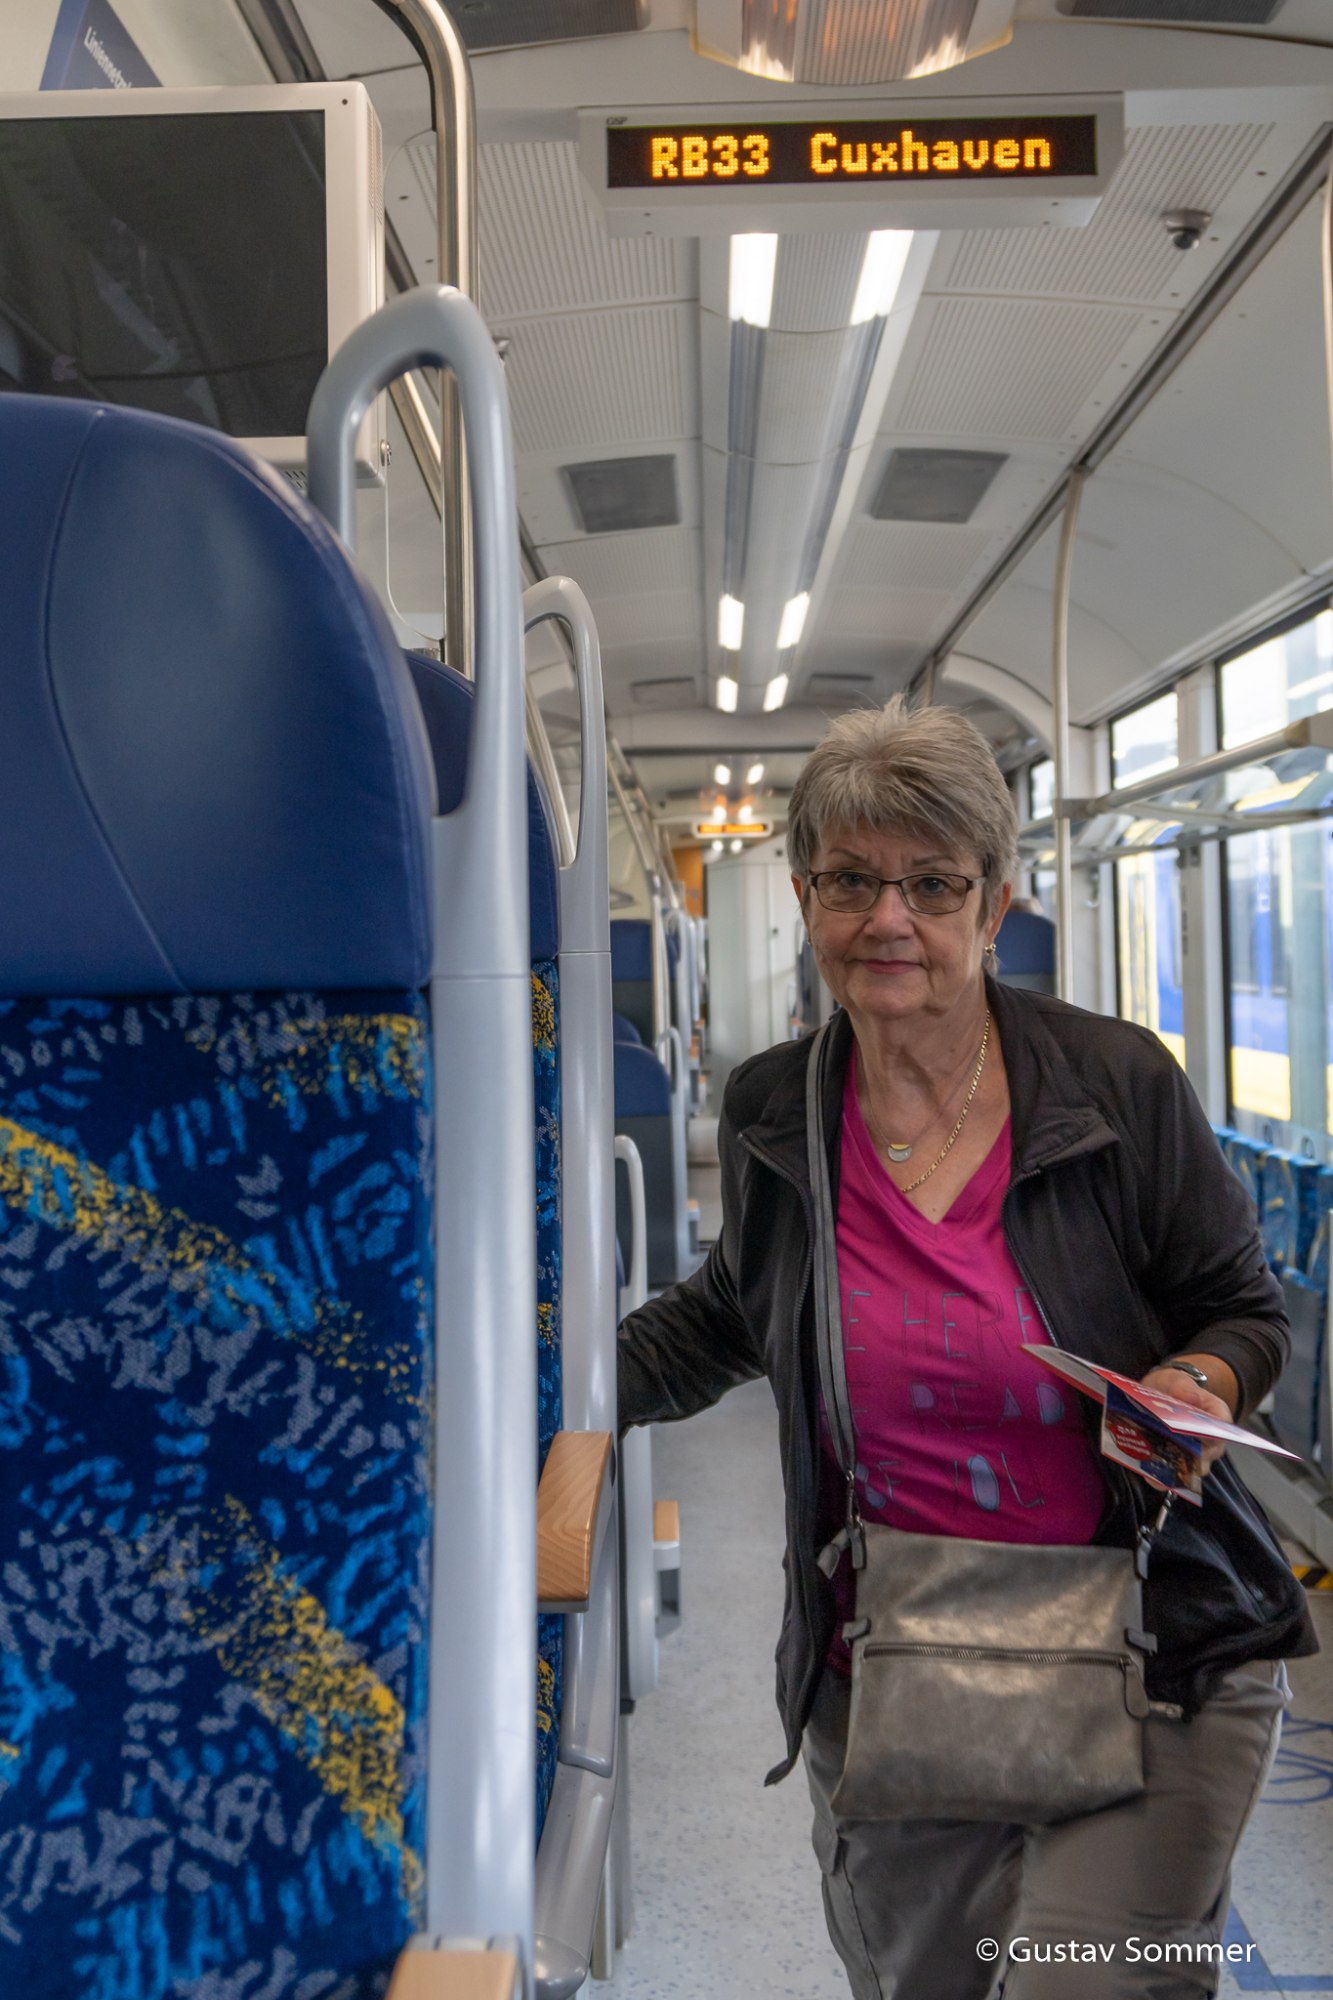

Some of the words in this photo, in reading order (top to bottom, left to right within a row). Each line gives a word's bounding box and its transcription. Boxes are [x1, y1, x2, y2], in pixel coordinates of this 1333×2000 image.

[83, 26, 132, 88] Liniennetz
[651, 133, 770, 178] RB33
[810, 129, 1051, 173] Cuxhaven
